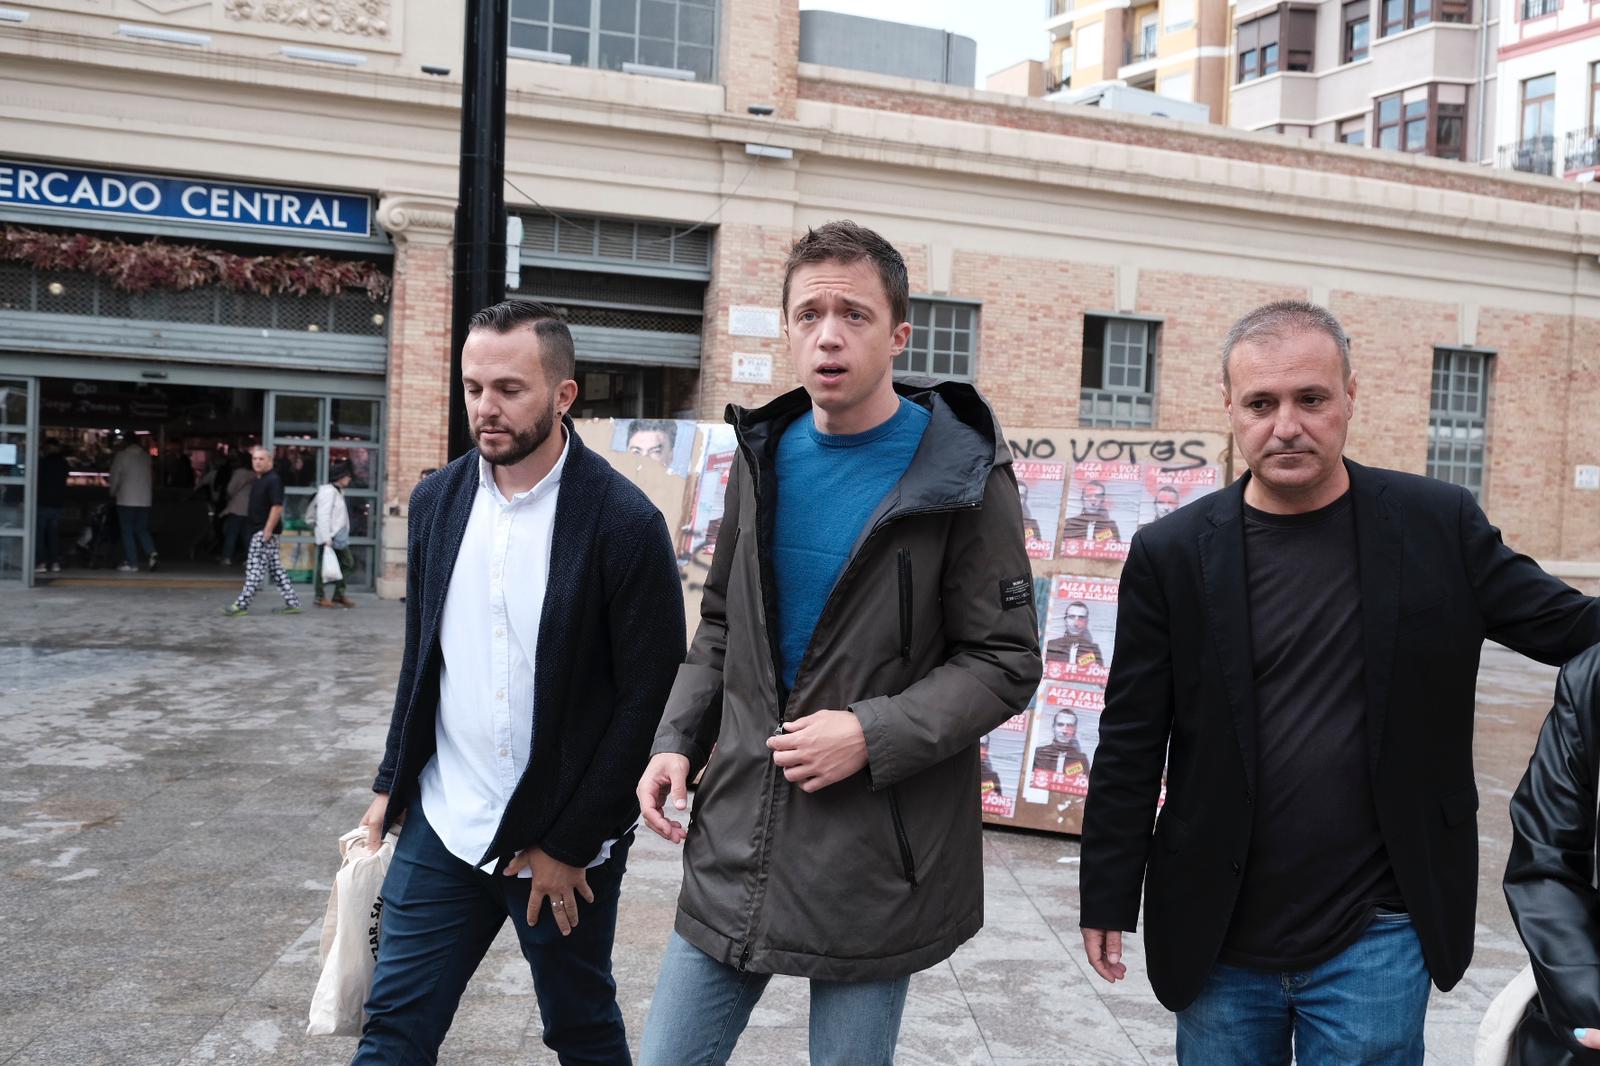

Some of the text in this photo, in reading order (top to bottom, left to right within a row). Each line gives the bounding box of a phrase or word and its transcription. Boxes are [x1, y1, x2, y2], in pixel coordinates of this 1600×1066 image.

[181, 185, 348, 228] CENTRAL
[1008, 438, 1056, 459] NO
[1041, 463, 1063, 474] VOZ
[1076, 462, 1103, 471] ALZA
[1119, 464, 1141, 474] VOZ
[1084, 471, 1140, 481] POR ALICANTE
[1059, 582, 1087, 593] ALZA
[1088, 584, 1102, 594] LA
[1048, 688, 1076, 700] ALZA
[1078, 691, 1091, 701] LA
[1056, 698, 1073, 706] POR
